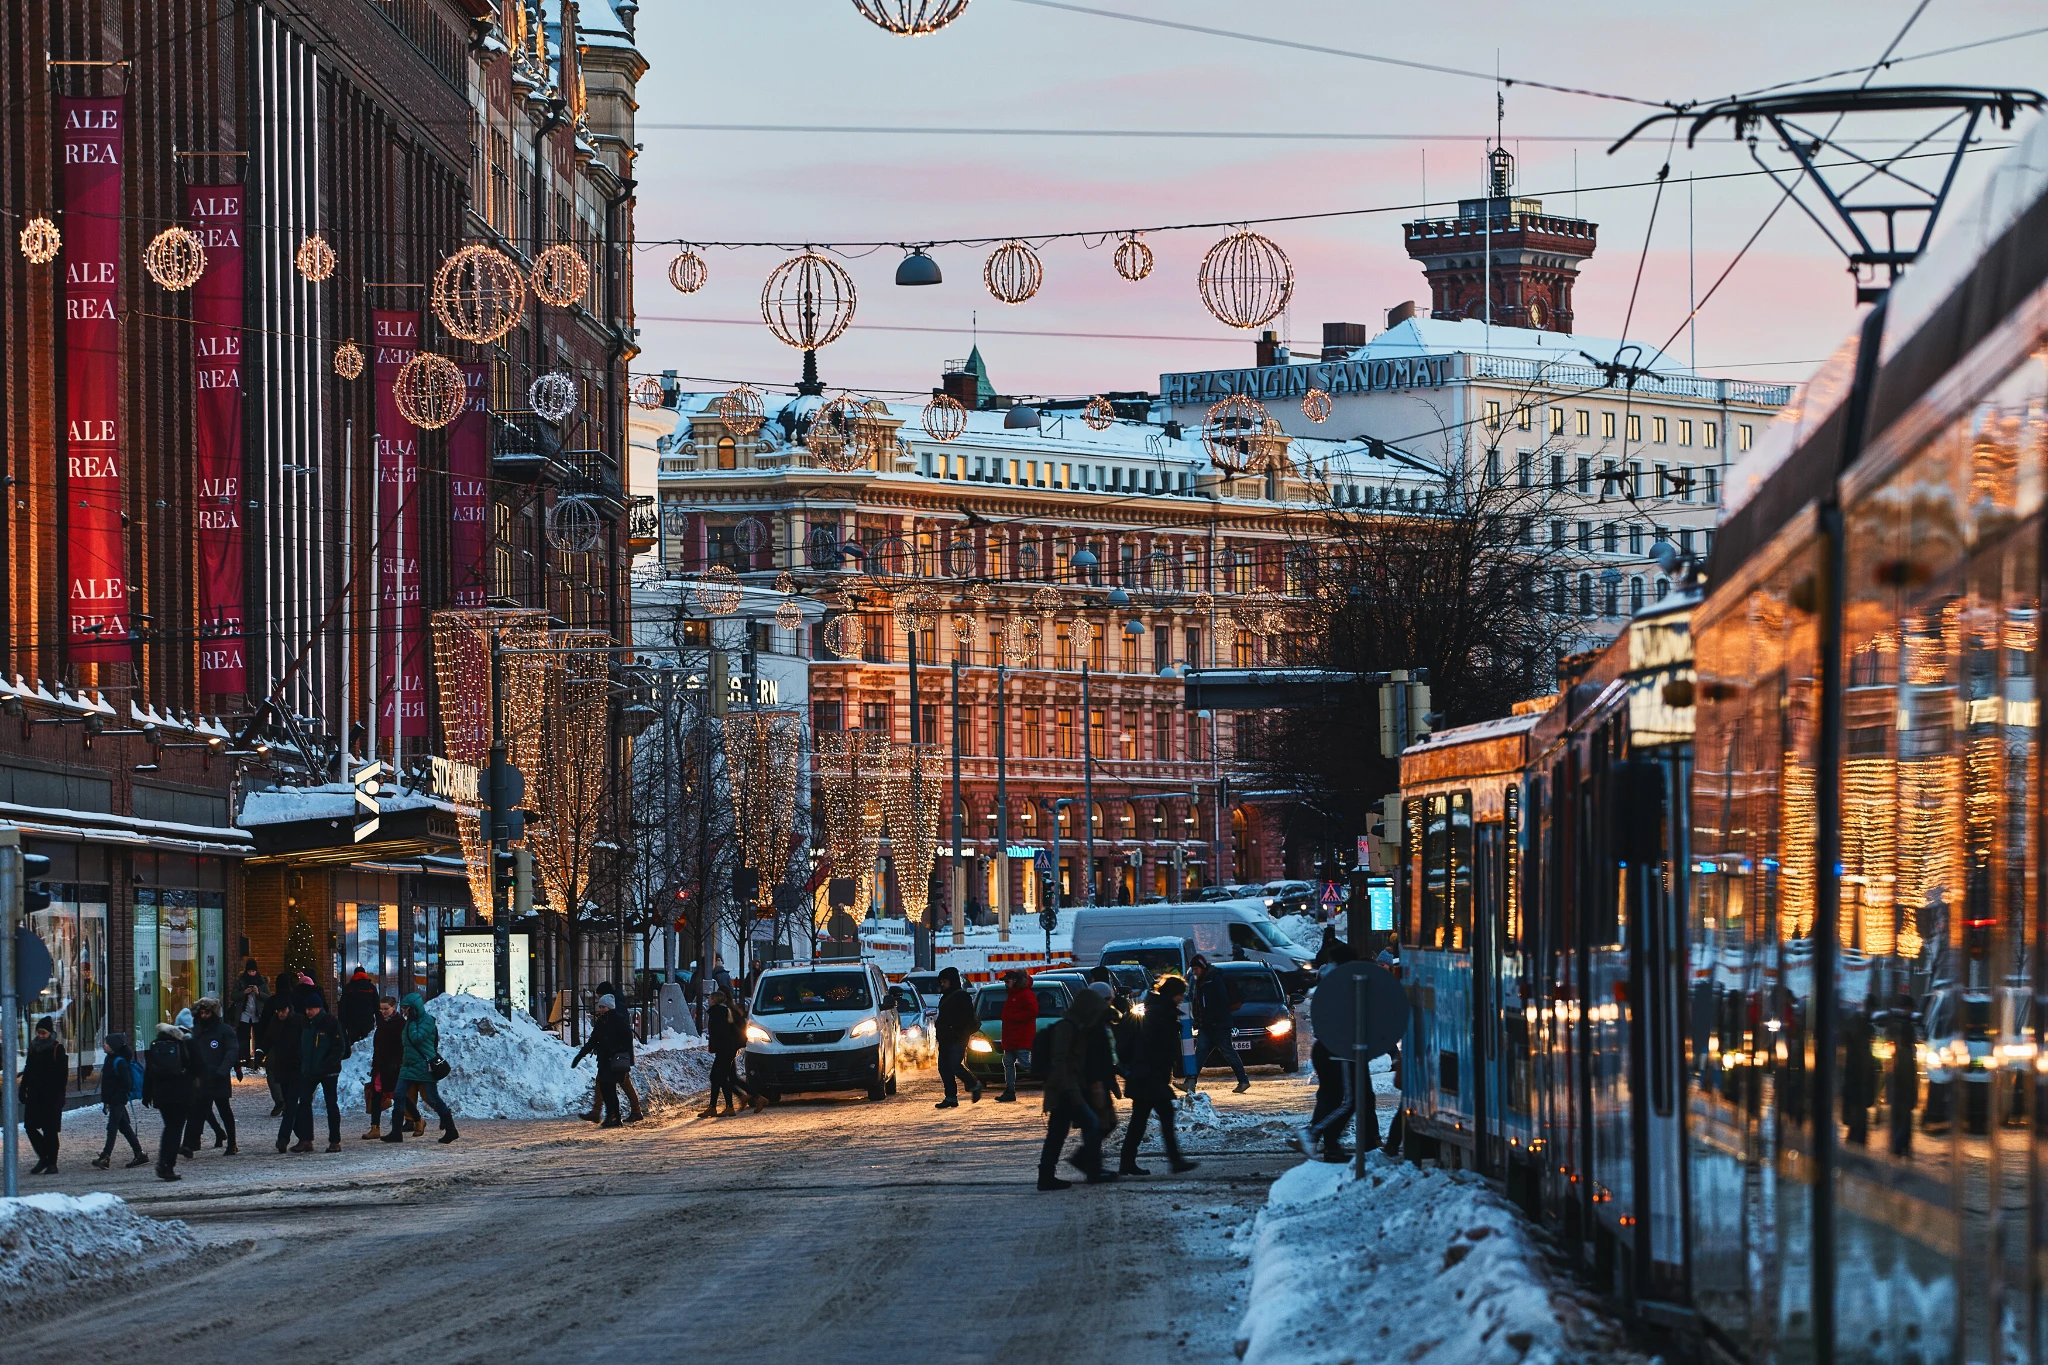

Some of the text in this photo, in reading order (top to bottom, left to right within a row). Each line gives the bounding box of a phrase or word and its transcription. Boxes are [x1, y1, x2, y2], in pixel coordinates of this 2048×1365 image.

[64, 109, 118, 130] ALE
[65, 143, 118, 165] REA
[191, 197, 239, 216] ALE
[192, 228, 240, 248] REA
[66, 262, 115, 284] ALE
[66, 299, 116, 320] REA
[197, 336, 239, 357] ALE
[199, 368, 240, 389] REA
[1166, 356, 1449, 405] HELSINGIN SANOMAT
[68, 420, 116, 441] ALE
[68, 456, 118, 478] REA
[199, 477, 237, 497] ALE
[199, 510, 239, 529] REA
[70, 578, 123, 600] ALE
[71, 614, 127, 635] REA
[201, 649, 243, 670] REA
